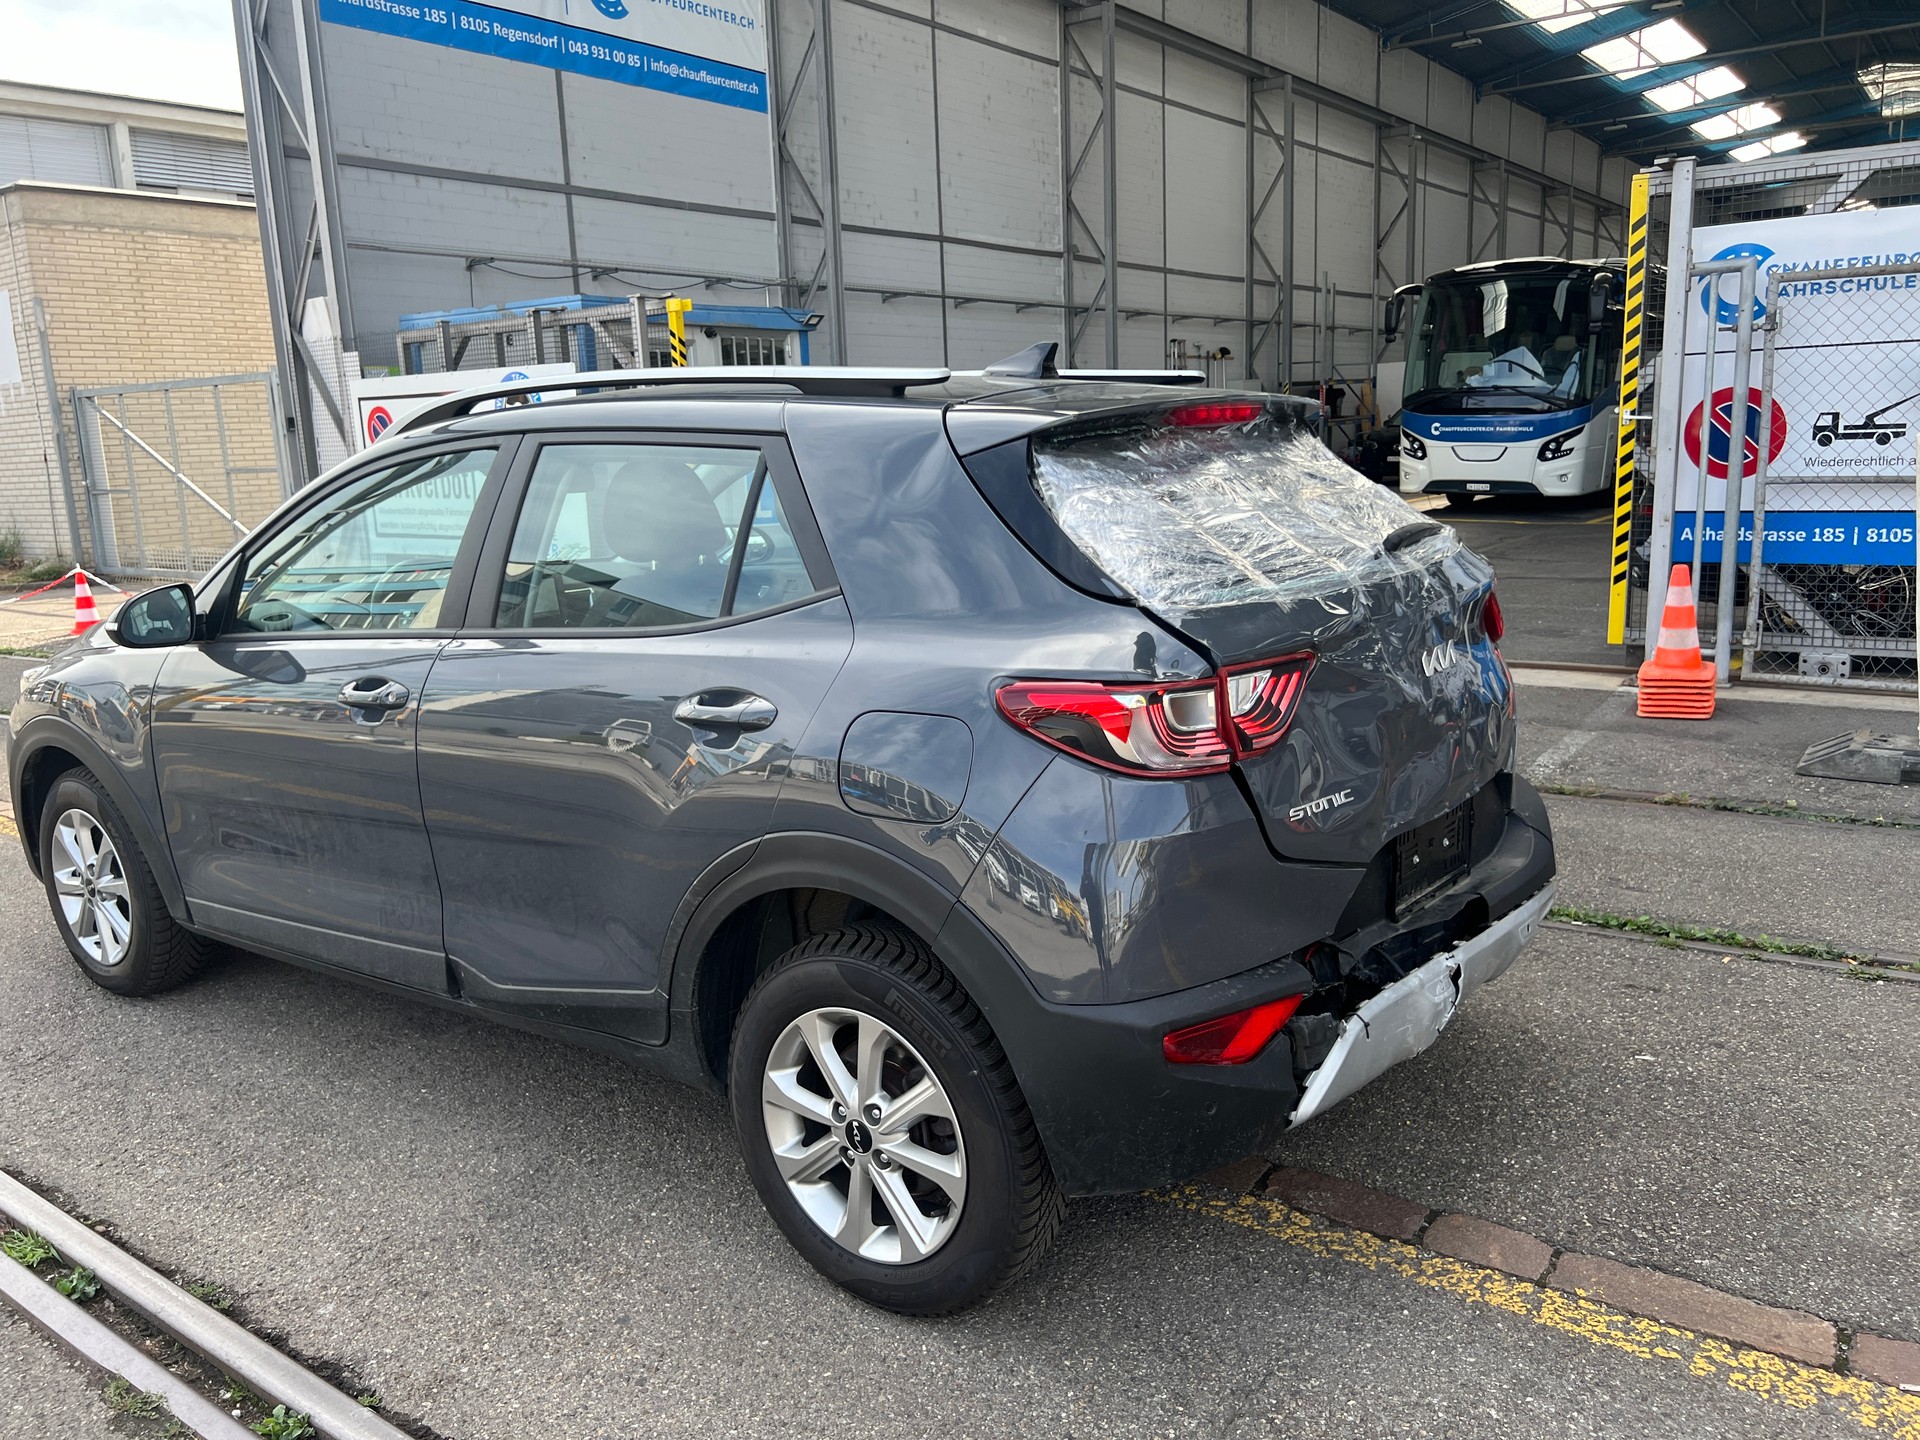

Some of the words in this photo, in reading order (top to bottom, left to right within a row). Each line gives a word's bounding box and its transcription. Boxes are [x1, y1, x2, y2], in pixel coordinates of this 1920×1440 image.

[423, 7, 448, 25] 185
[460, 15, 490, 35] 8105
[493, 22, 559, 49] Regensdorf
[568, 40, 590, 57] 043
[591, 44, 611, 61] 931
[612, 50, 626, 65] 00
[627, 53, 641, 68] 85
[650, 58, 759, 96] info@chauffeurcenter.ch
[1804, 456, 1905, 468] Wiederrechtlich
[1811, 527, 1845, 543] 185
[1866, 528, 1914, 543] 8105
[1289, 789, 1355, 822] STONIC
